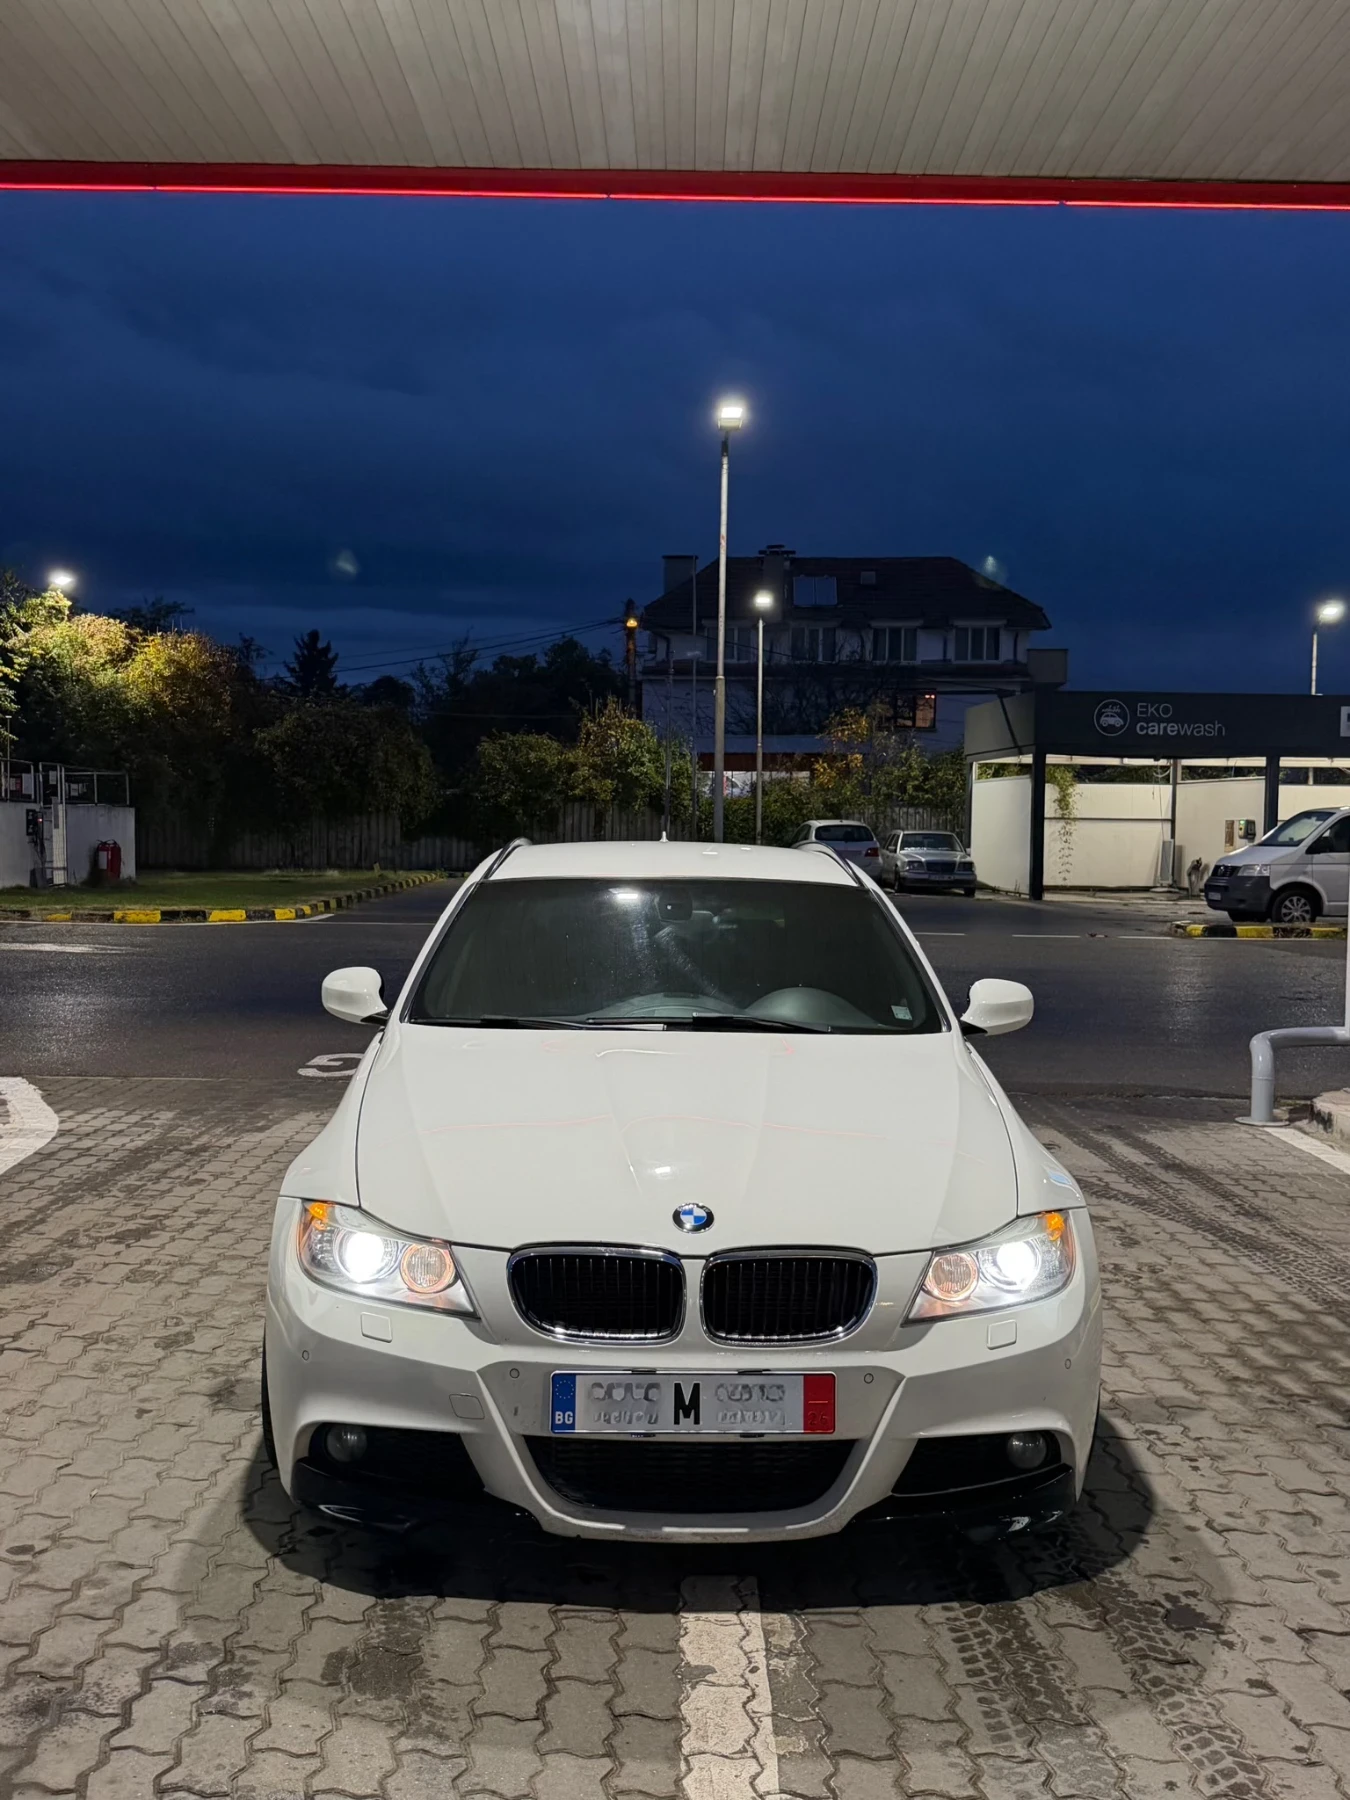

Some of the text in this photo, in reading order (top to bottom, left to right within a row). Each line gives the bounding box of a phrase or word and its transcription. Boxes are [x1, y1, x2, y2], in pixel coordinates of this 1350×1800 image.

[1136, 703, 1173, 718] EKO
[1136, 721, 1226, 737] carewash
[673, 1382, 701, 1426] M
[555, 1410, 574, 1425] BG
